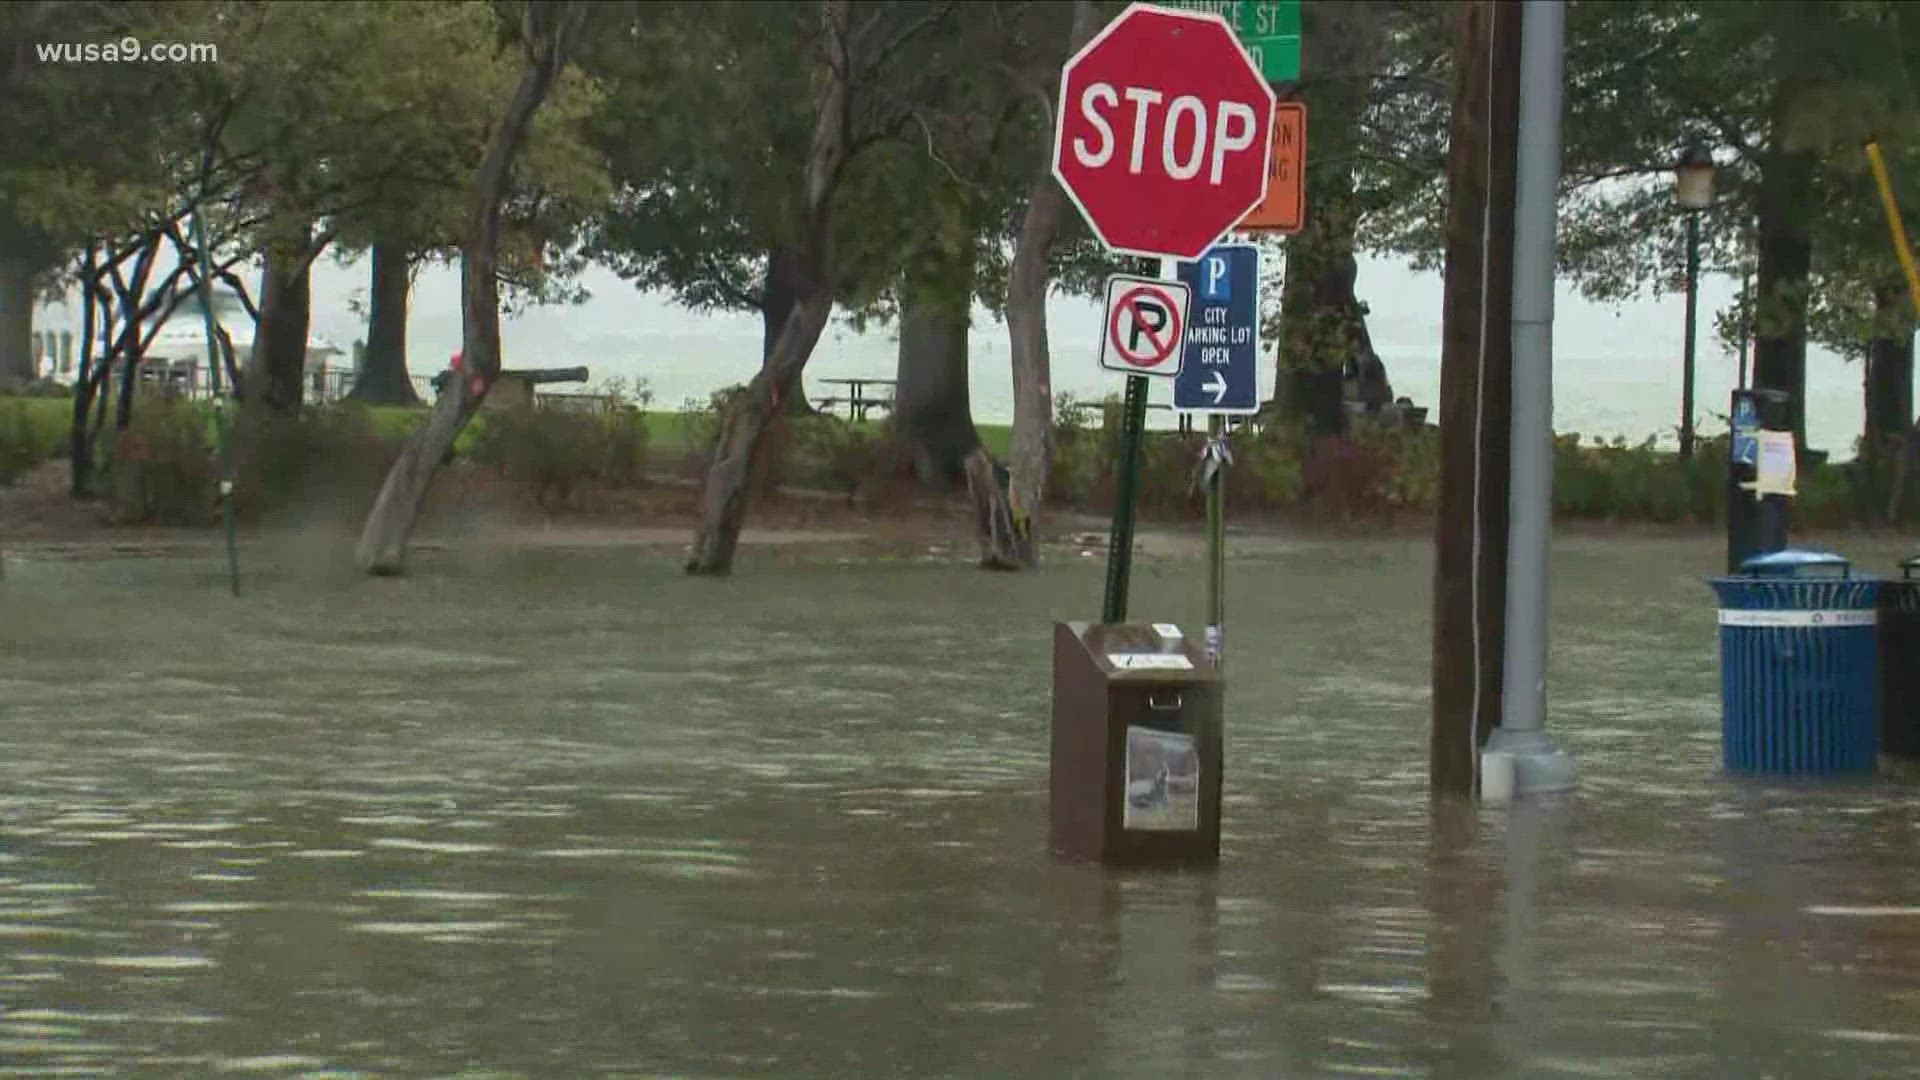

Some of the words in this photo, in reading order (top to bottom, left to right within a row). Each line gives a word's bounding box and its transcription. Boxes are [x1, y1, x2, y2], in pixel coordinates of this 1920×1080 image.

[1256, 5, 1280, 36] ST
[1073, 82, 1257, 185] STOP
[1207, 258, 1226, 295] P
[1204, 308, 1227, 323] CITY
[1188, 326, 1226, 344] ARKING
[1231, 326, 1251, 344] LOT
[1201, 348, 1230, 366] OPEN
